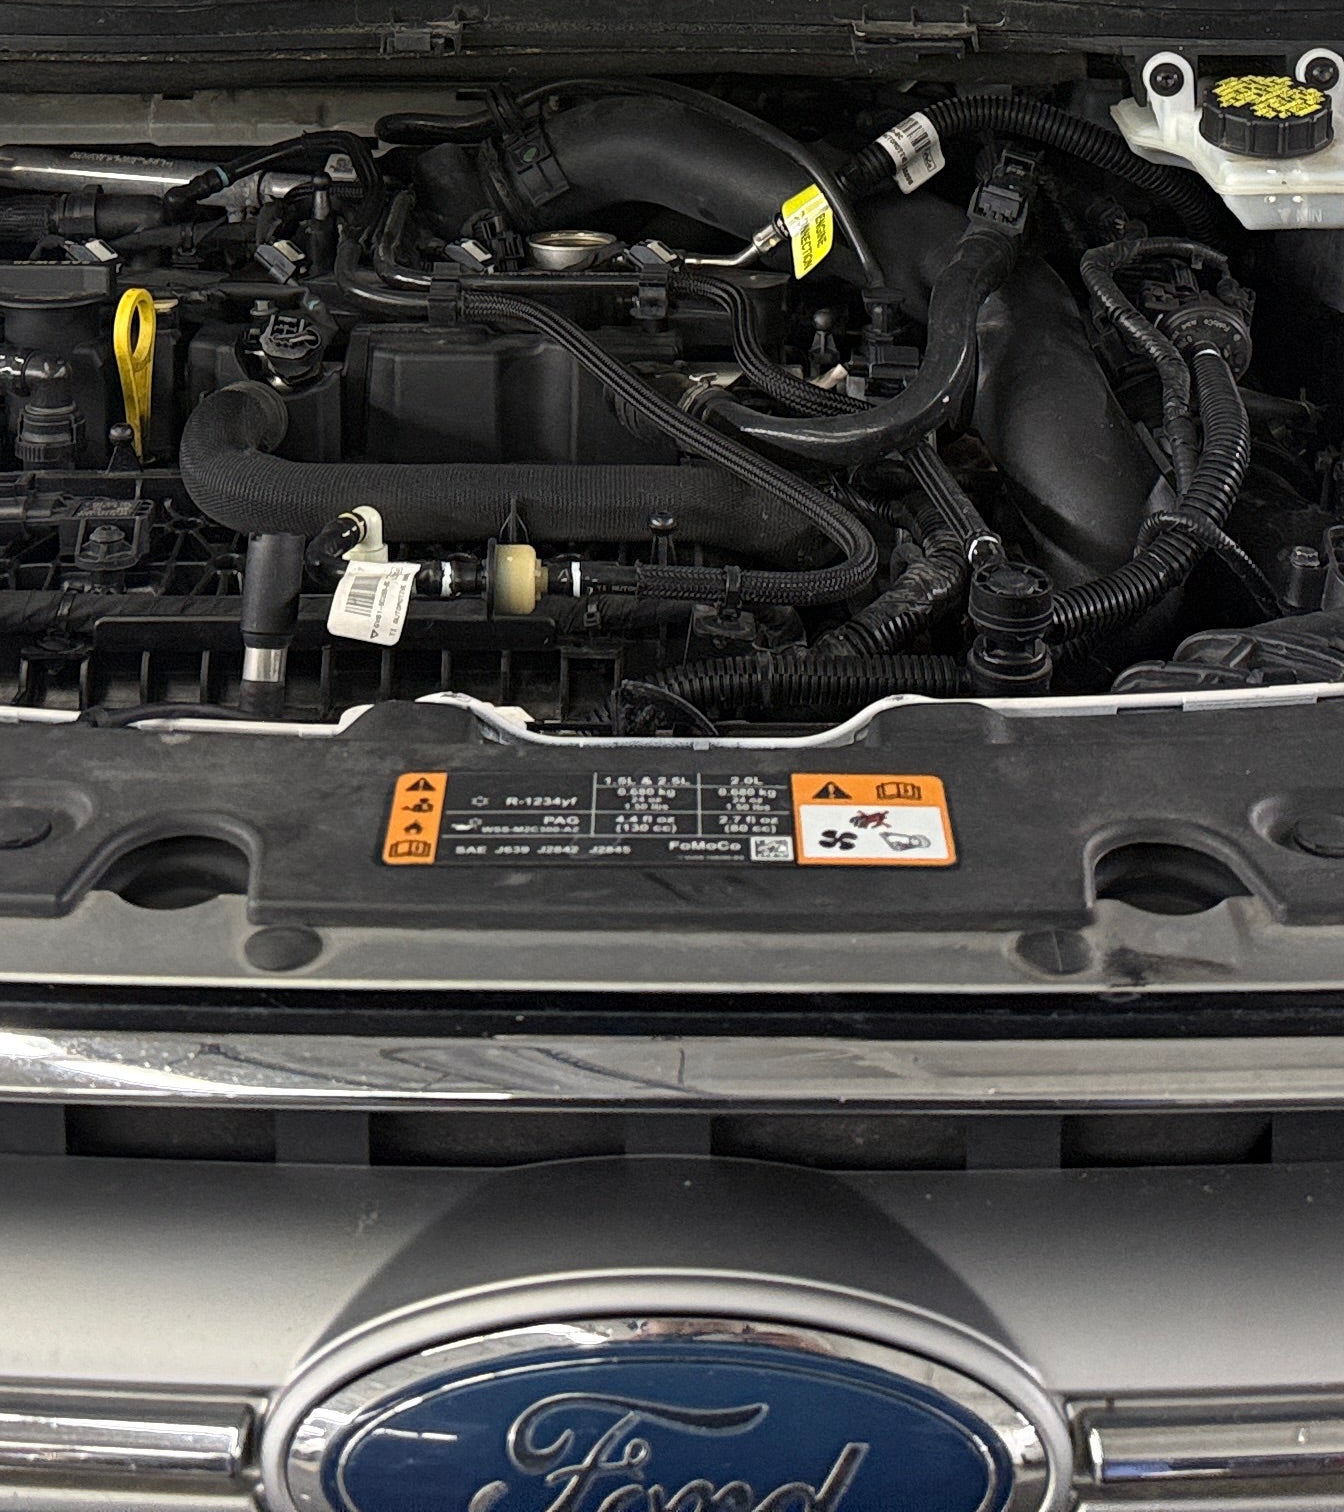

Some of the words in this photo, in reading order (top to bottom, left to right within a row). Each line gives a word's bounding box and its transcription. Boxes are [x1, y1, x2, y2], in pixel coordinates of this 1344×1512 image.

[816, 213, 827, 249] ENGINE
[506, 796, 578, 808] R-1234yf
[543, 816, 580, 825] PAG
[455, 845, 488, 855] SAE
[668, 840, 742, 851] FoMoCo
